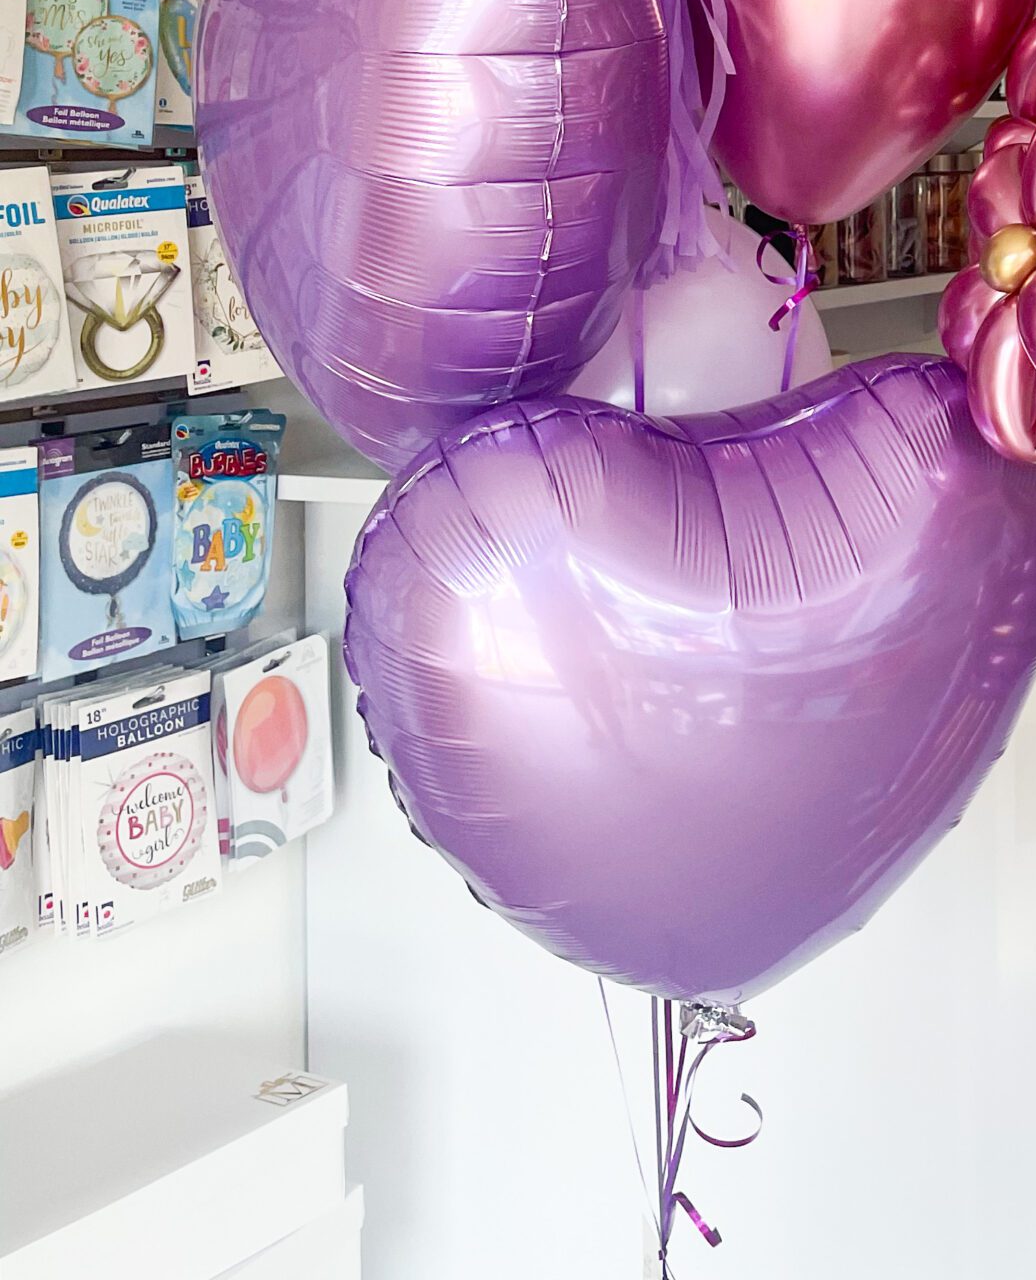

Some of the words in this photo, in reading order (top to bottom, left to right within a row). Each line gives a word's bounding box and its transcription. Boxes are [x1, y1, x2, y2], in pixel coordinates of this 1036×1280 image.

[42, 116, 68, 125] Ballon
[54, 108, 69, 117] Foil
[70, 109, 100, 119] Balloon
[91, 195, 150, 213] Qualatex
[83, 221, 143, 234] MICROFOIL
[142, 440, 171, 451] Standard
[189, 448, 268, 480] BUBBLES
[85, 541, 118, 568] STAR
[191, 518, 260, 572] BABY
[87, 707, 107, 725] 18"
[97, 699, 200, 740] HOLOGRAPHIC
[117, 716, 185, 748] BALLOON
[1, 737, 24, 755] HIC
[120, 782, 188, 815] welcome
[127, 798, 184, 840] BABY
